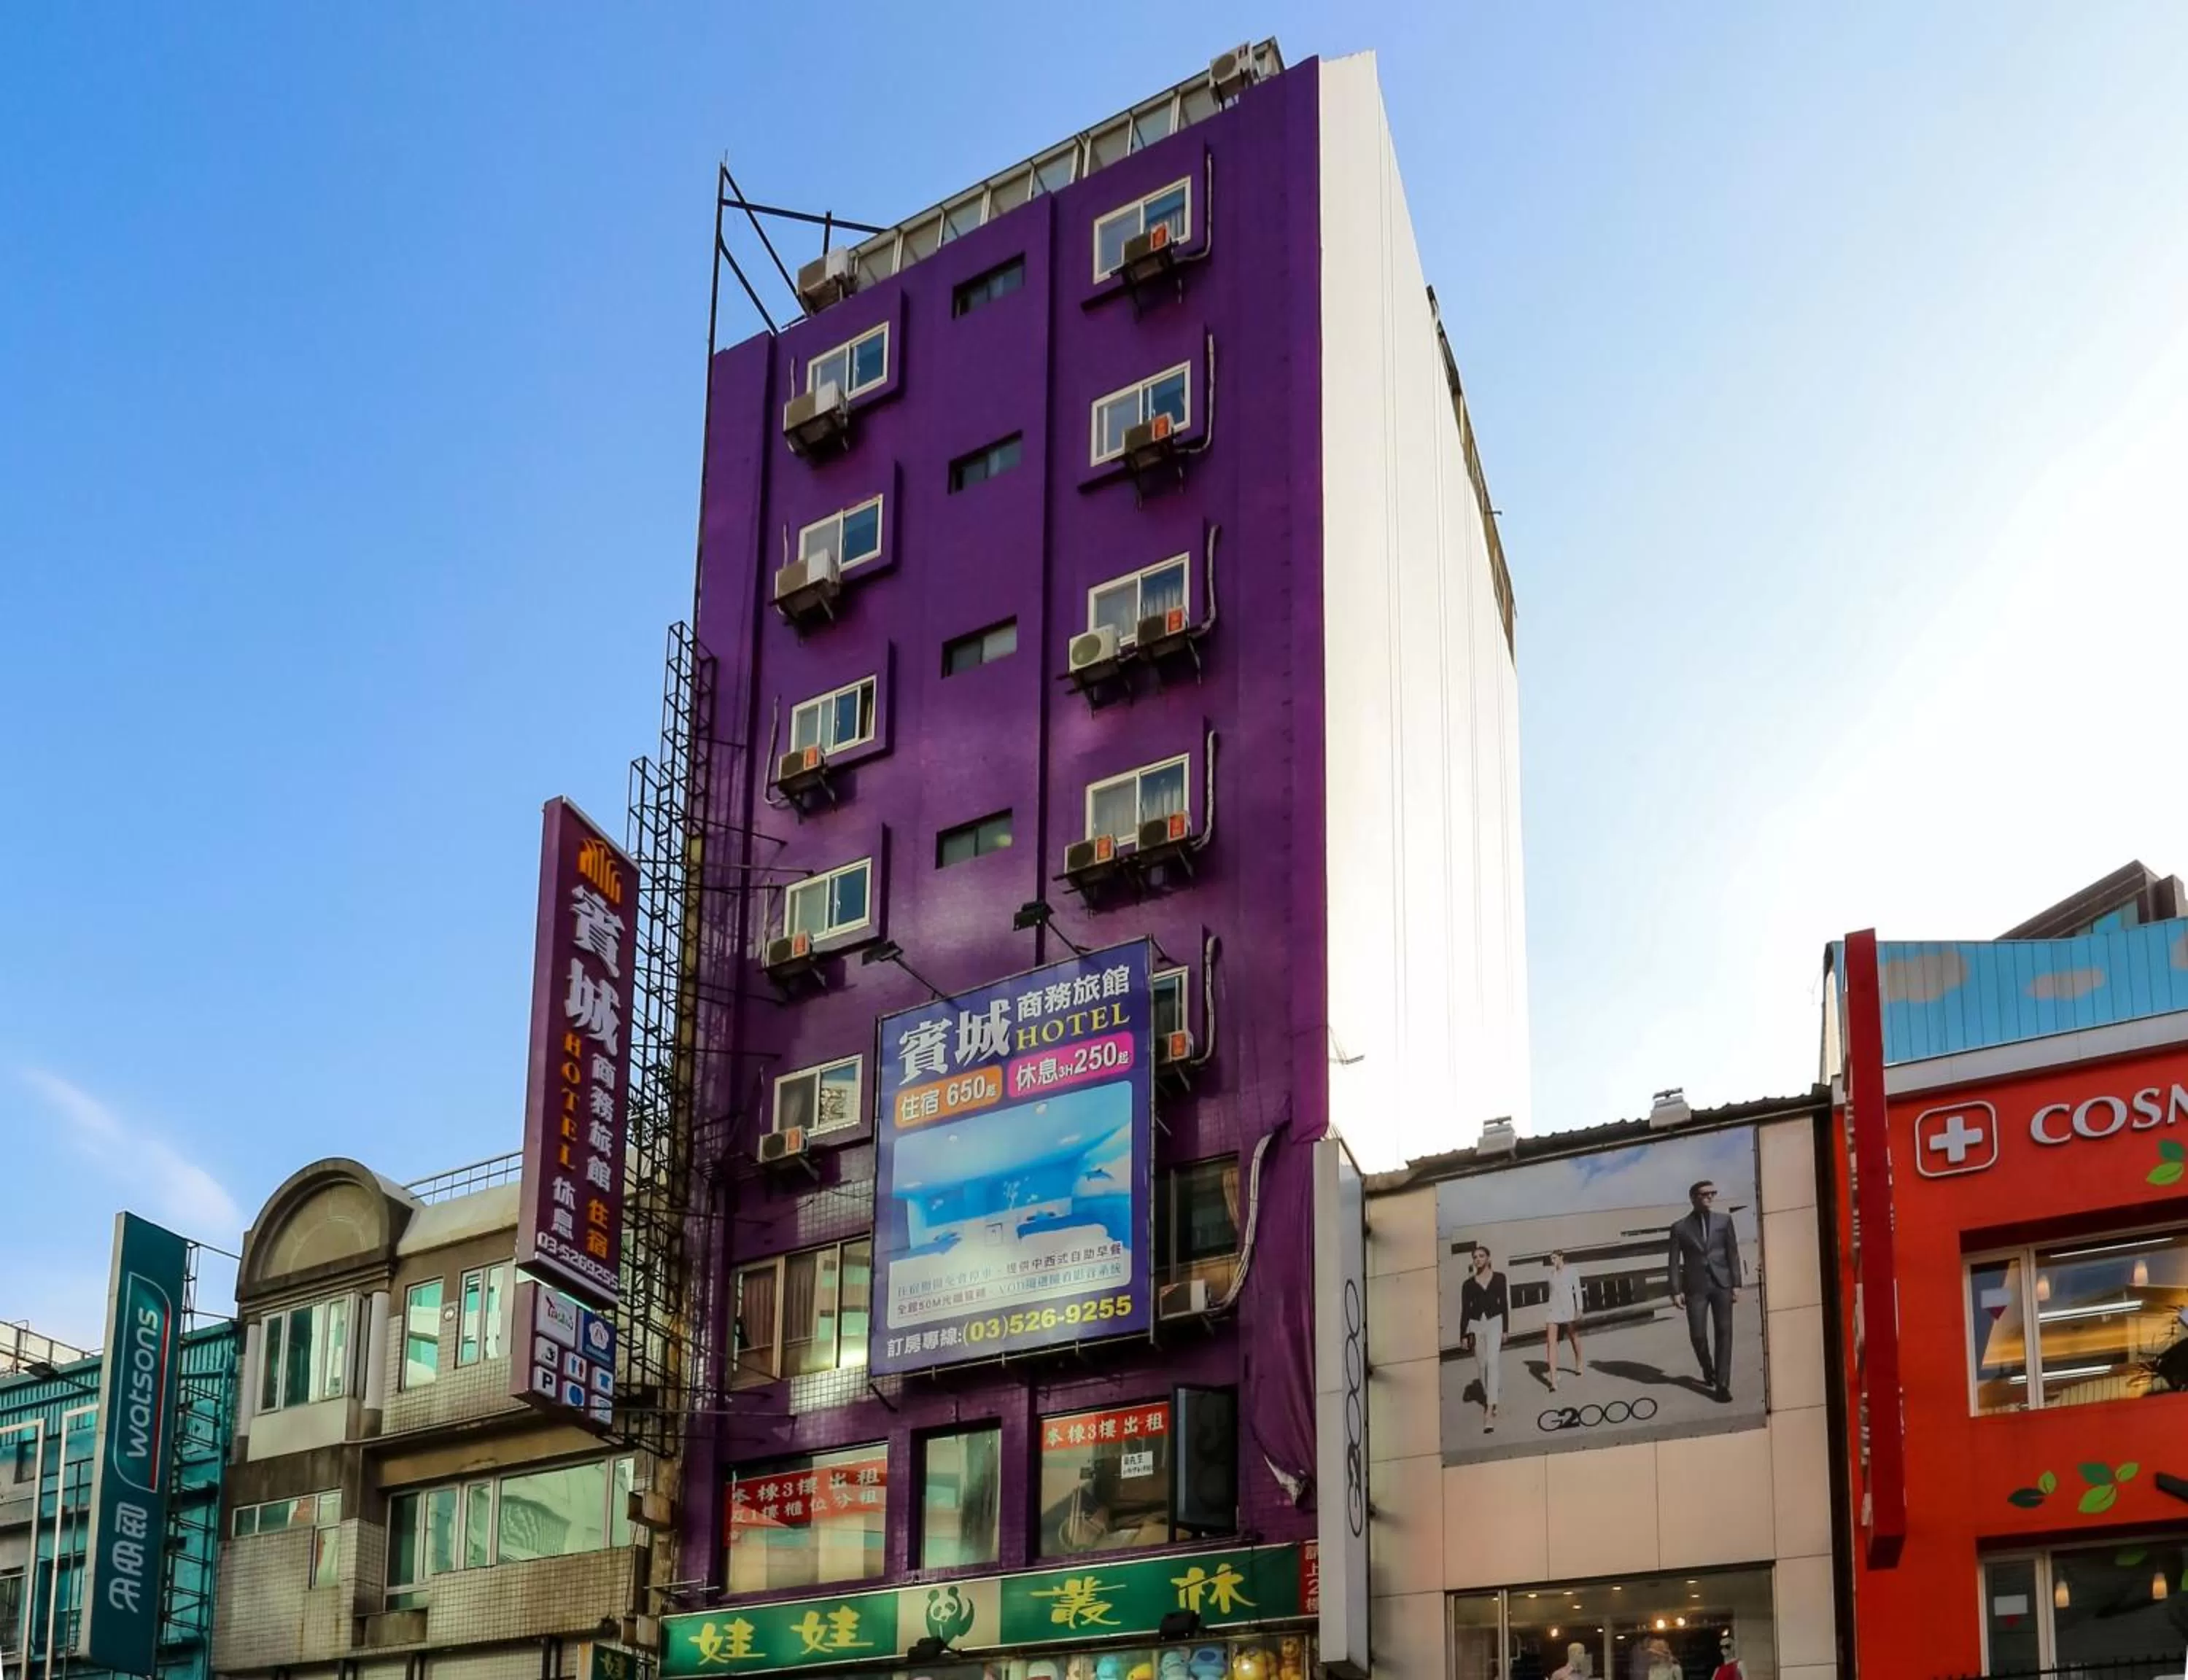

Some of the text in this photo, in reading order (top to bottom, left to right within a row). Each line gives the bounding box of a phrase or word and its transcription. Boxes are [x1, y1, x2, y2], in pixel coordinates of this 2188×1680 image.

[565, 884, 625, 1056] 賓城
[1017, 965, 1130, 1021] 商務旅館
[899, 998, 1012, 1086] 賓城
[1017, 1003, 1130, 1051] HOTEL
[559, 1032, 581, 1170] HOTEL
[586, 1053, 616, 1193] 商務旅館
[551, 1176, 576, 1241] 休息
[586, 1198, 609, 1260] 住宿
[537, 1232, 619, 1291] 03-5269255
[126, 1306, 158, 1458] watsons
[1344, 1278, 1362, 1538] G2000
[1537, 1396, 1658, 1432] G2000
[109, 1501, 148, 1614] 屈臣氏
[688, 1605, 874, 1666] 娃娃
